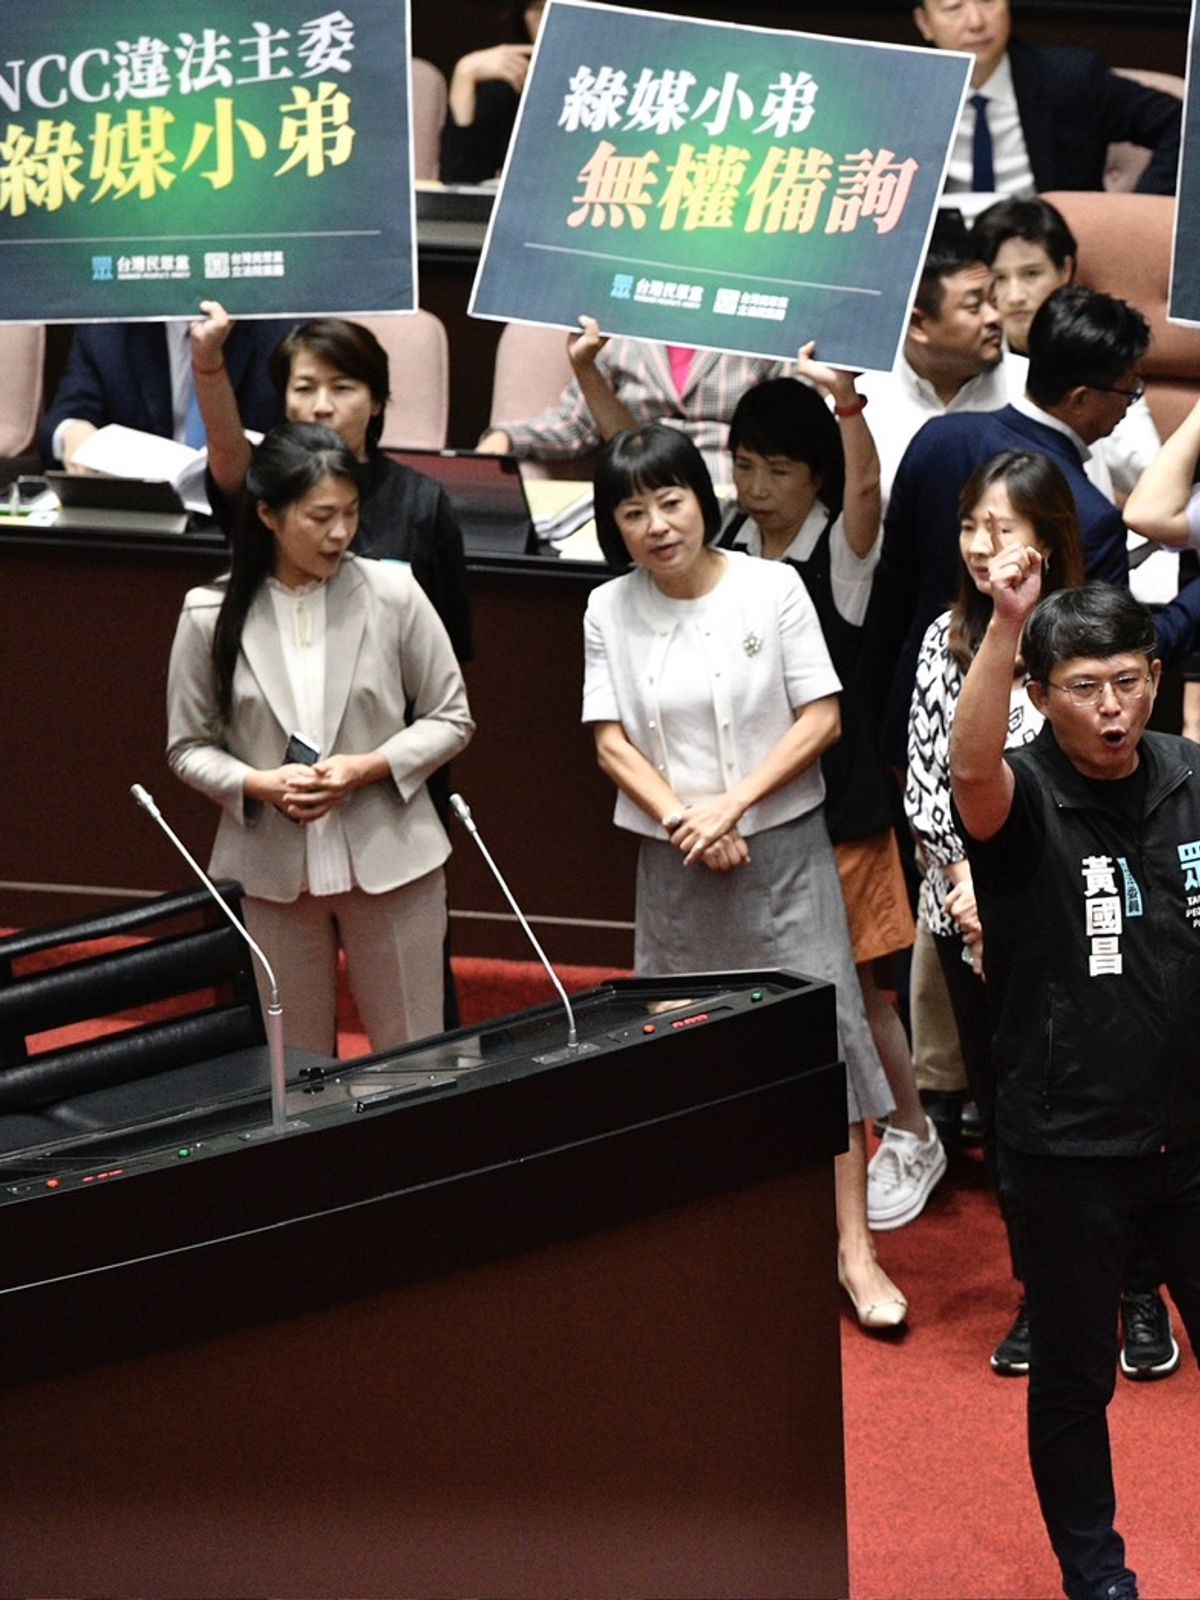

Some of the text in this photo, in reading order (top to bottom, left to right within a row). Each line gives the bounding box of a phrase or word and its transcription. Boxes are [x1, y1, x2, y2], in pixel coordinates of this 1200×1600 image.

[0, 81, 355, 216] 綠媒小弟
[557, 65, 819, 137] 綠媒小弟
[566, 140, 919, 235] 無權備詢
[1081, 855, 1123, 977] 黃國昌
